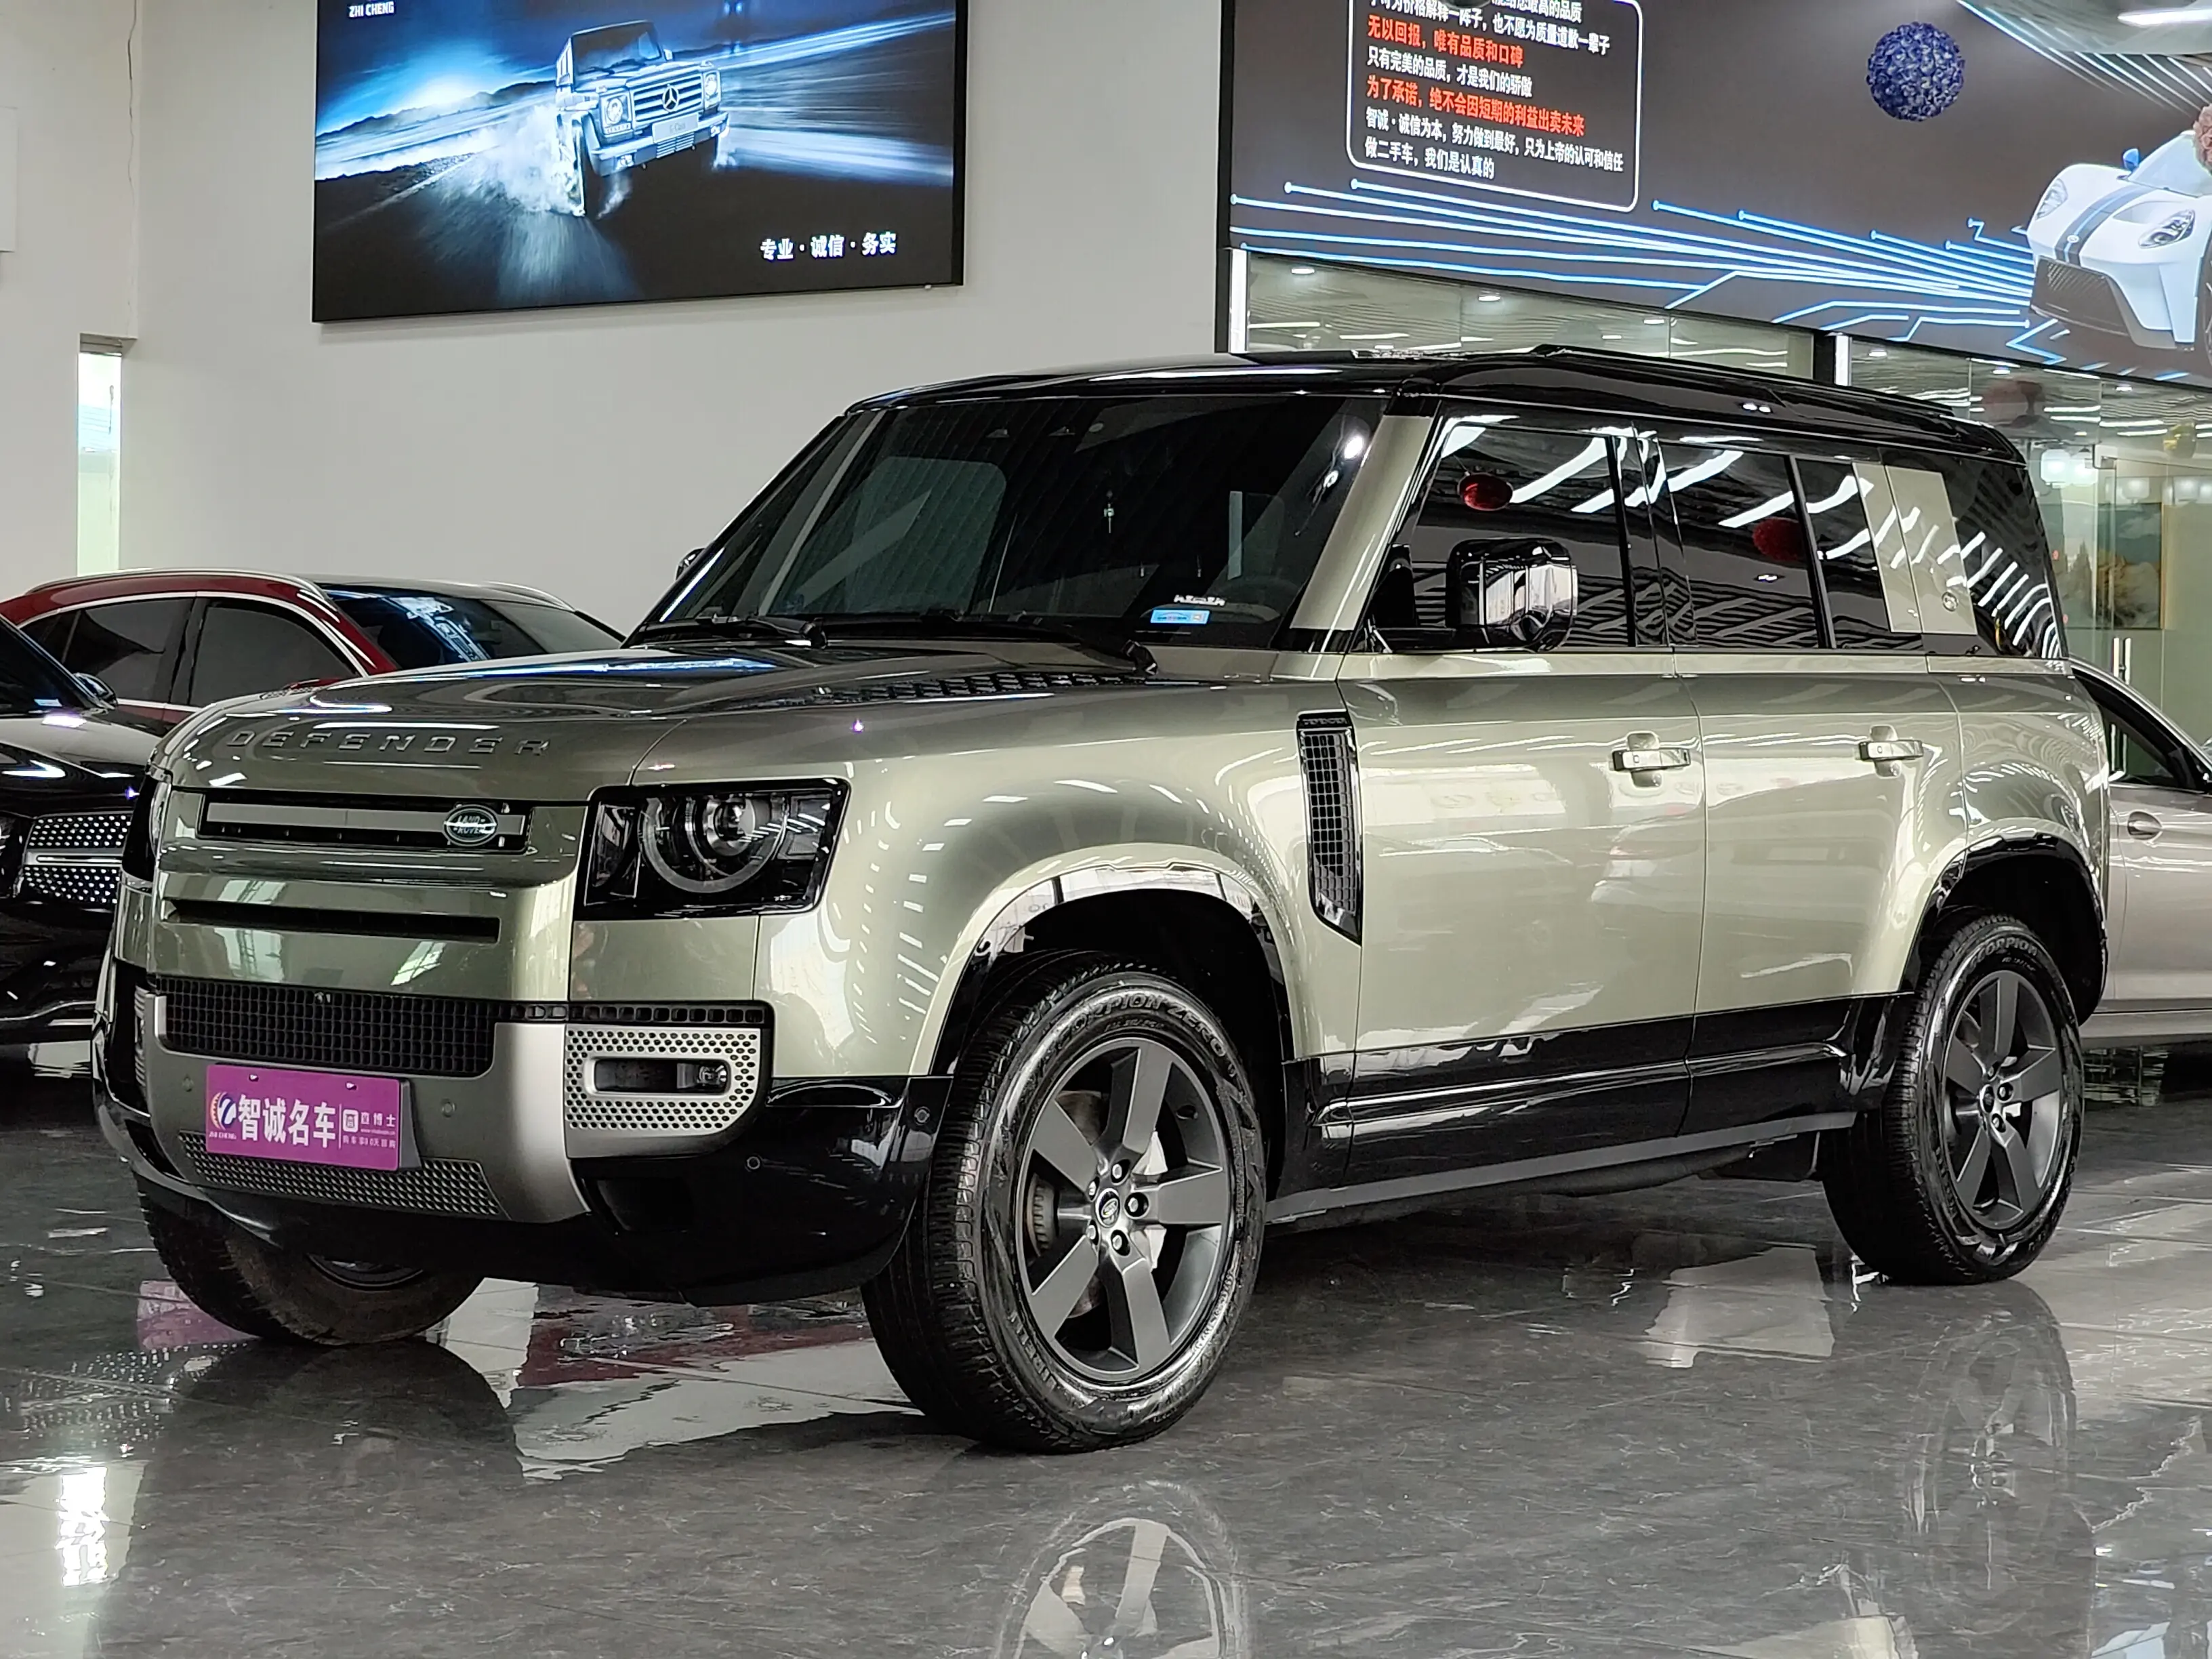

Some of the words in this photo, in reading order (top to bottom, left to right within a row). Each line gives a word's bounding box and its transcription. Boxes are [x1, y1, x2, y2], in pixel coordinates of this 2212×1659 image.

[348, 5, 364, 18] ZHI
[365, 1, 394, 16] CHENG
[1364, 136, 1495, 179] 做二手车，我们是认真的
[226, 730, 550, 756] DEFENDER
[1167, 1002, 1227, 1058] ZERO
[238, 1094, 337, 1149] 智诚名车
